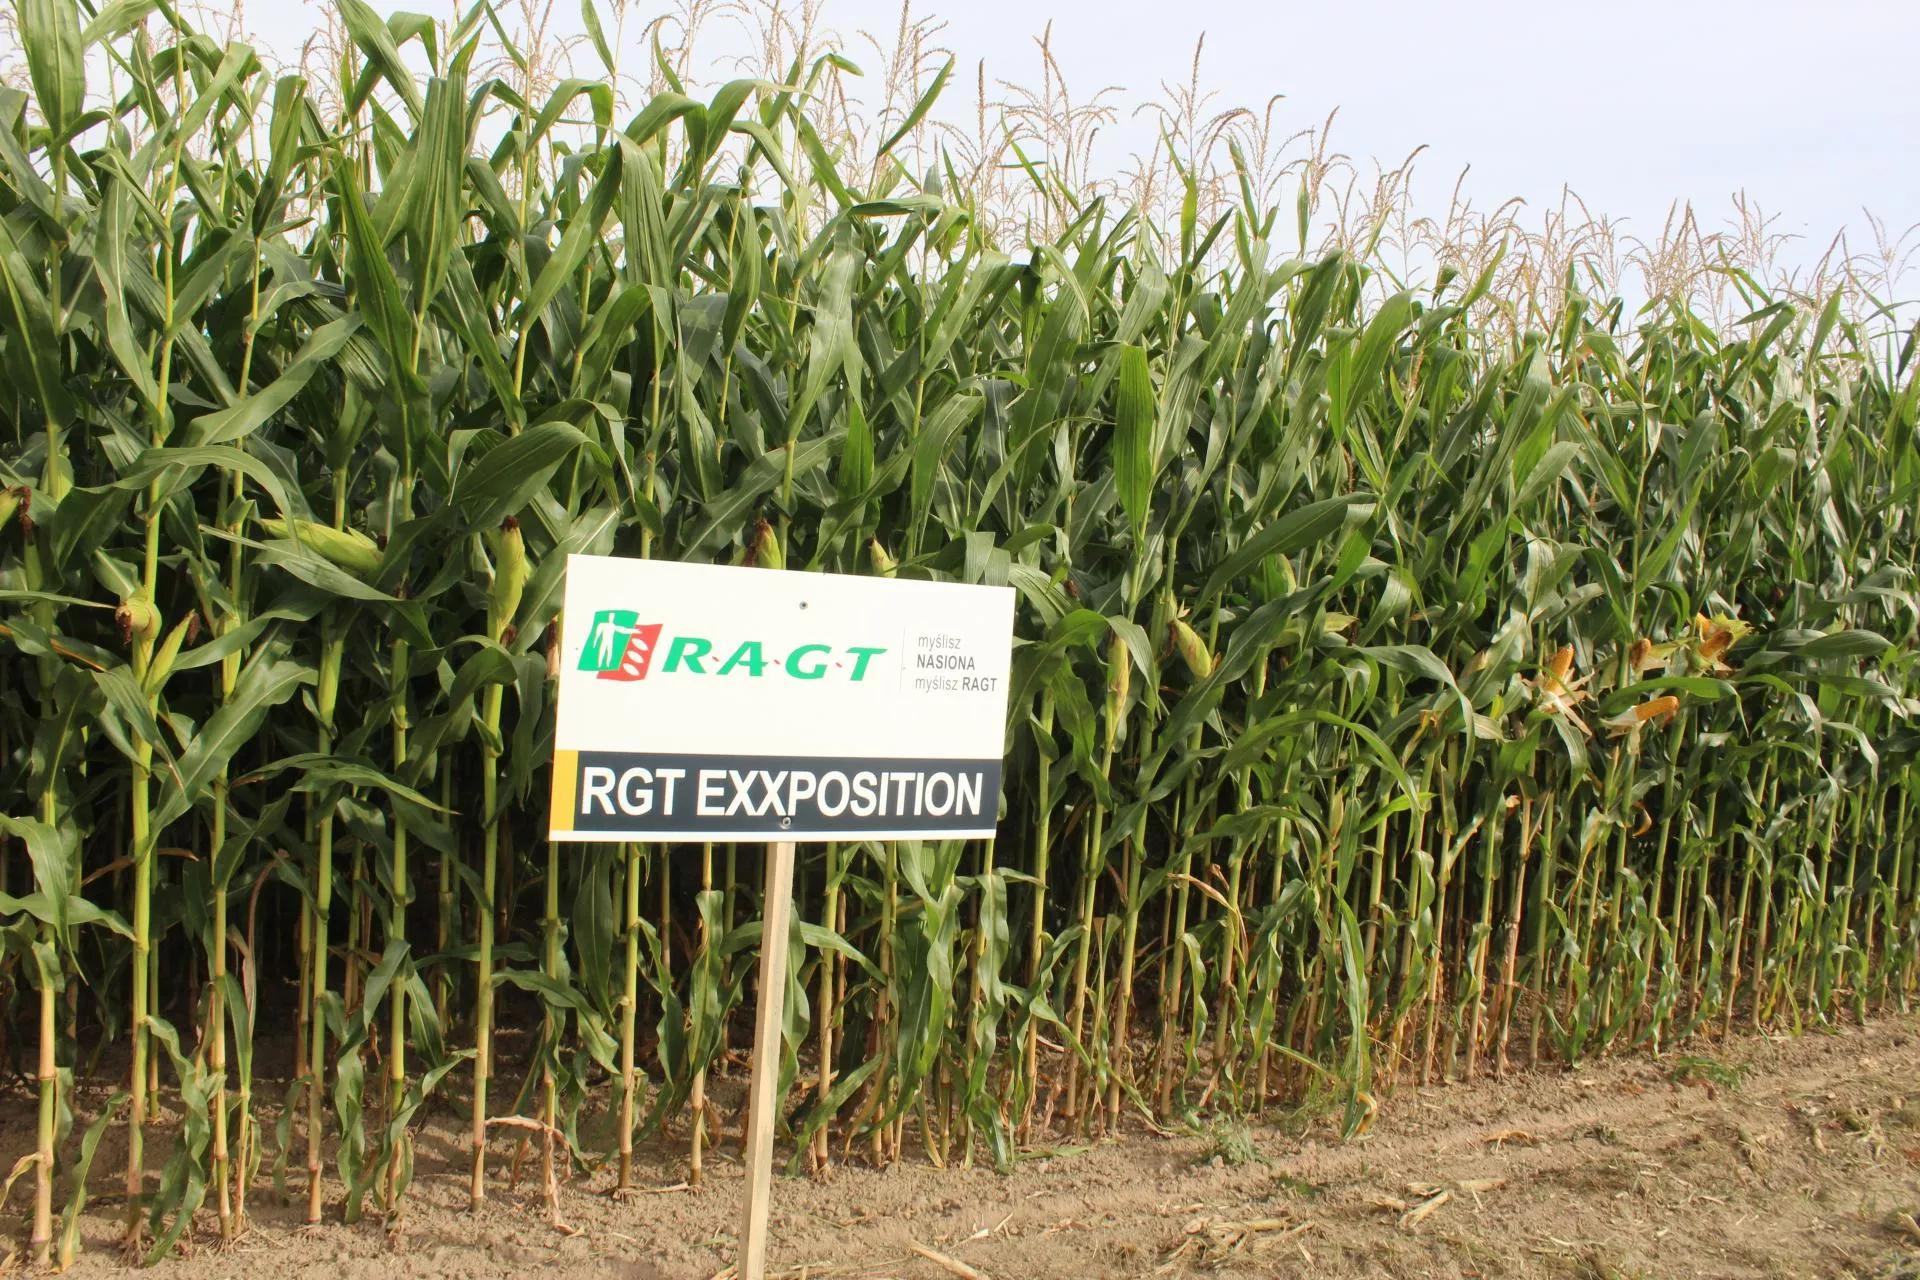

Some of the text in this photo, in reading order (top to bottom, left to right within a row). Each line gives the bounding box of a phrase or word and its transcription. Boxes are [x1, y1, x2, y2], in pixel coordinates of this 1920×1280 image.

[917, 634, 962, 652] myślisz
[916, 653, 976, 671] NASIONA
[915, 675, 998, 694] myślisz RAGT
[581, 767, 983, 817] RGT EXXPOSITION
